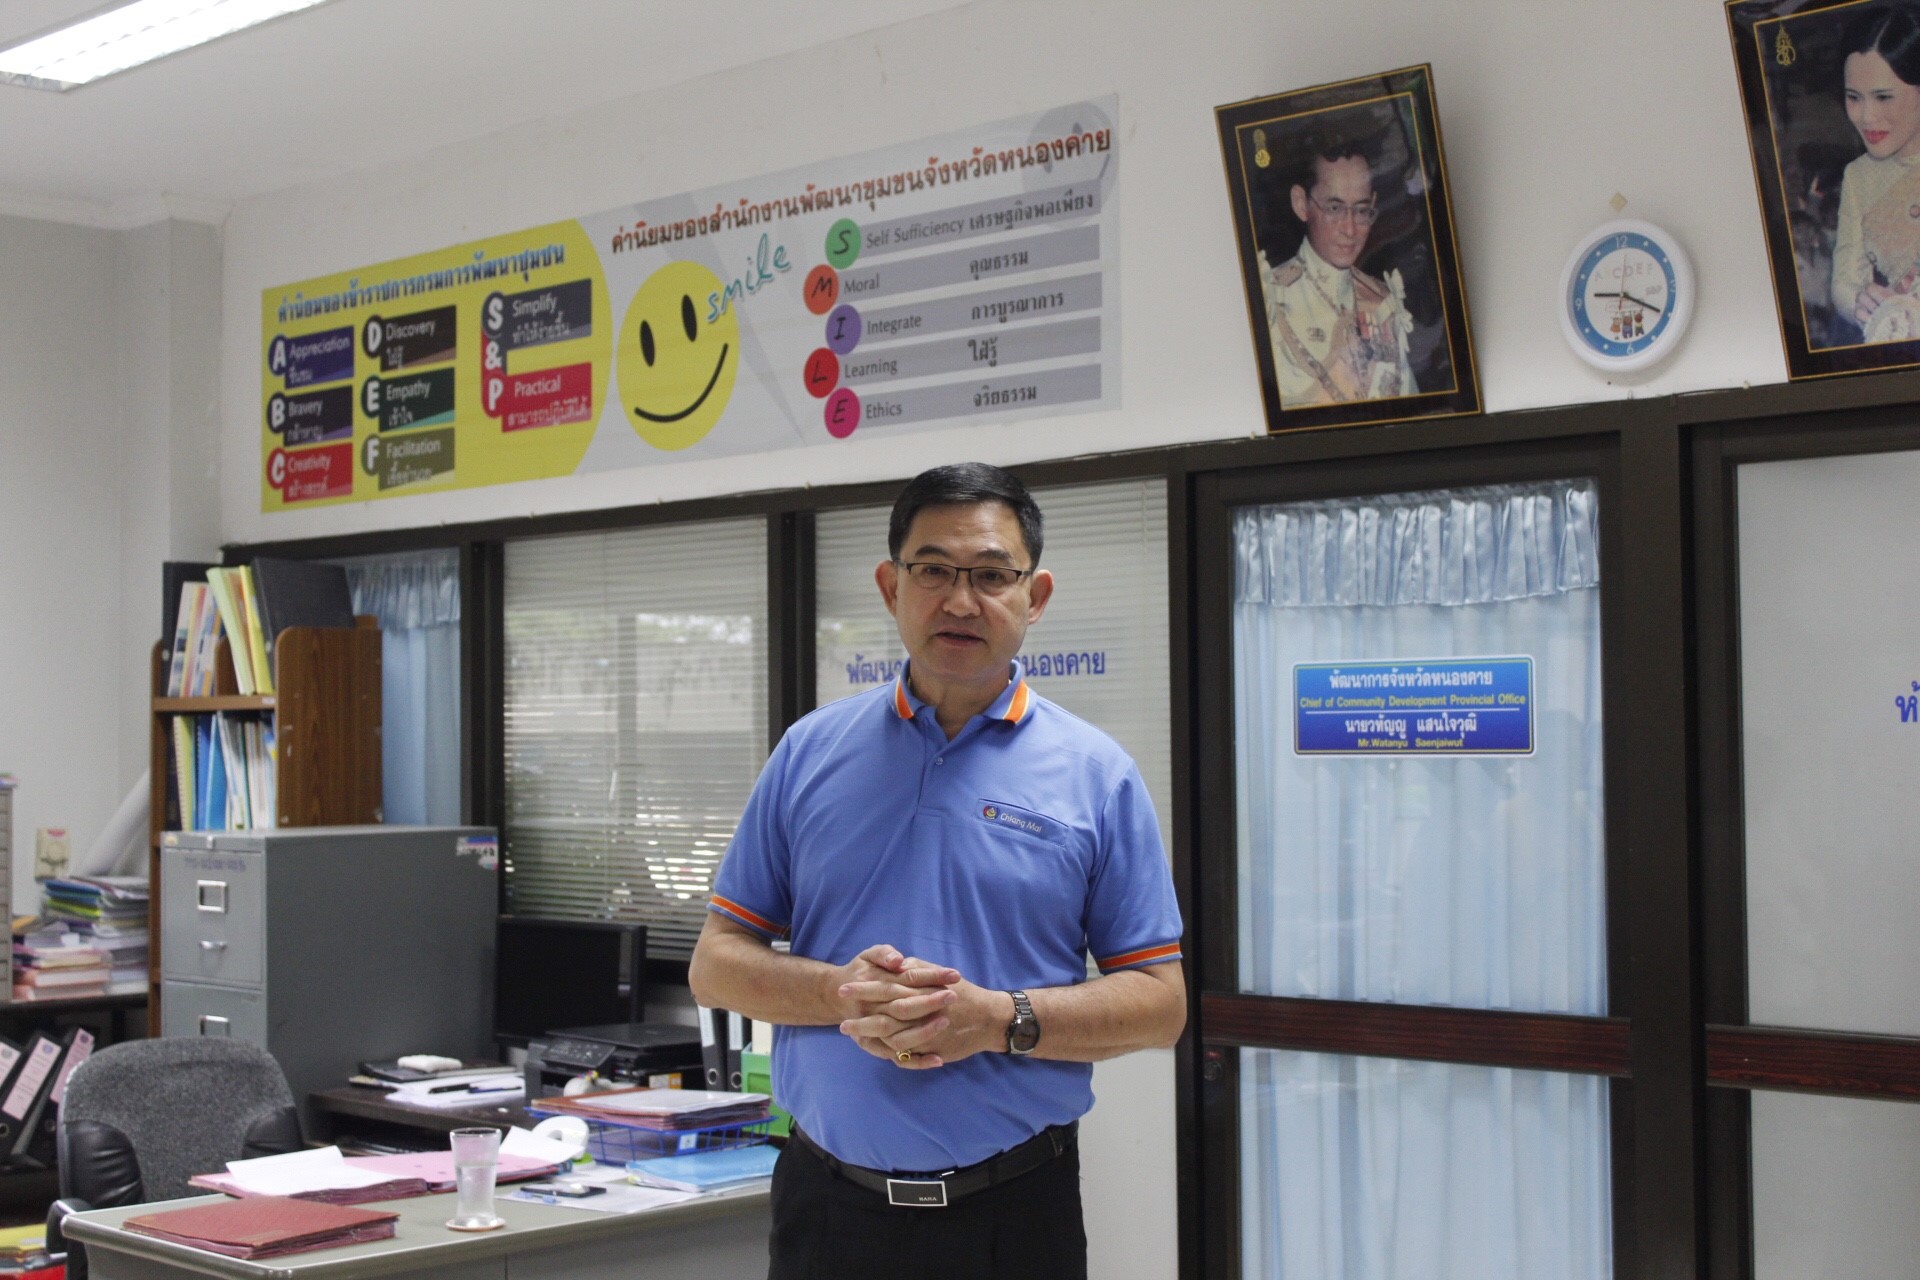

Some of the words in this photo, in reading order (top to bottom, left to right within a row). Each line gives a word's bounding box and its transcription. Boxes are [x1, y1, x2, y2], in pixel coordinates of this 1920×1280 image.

[612, 128, 1111, 254] ค่านิยมของสำนักงานพัฒนาชุมชนจังหวัดหนองคาย
[970, 188, 1094, 231] เศรษฐกิจพอเพียง
[866, 228, 890, 249] Self
[894, 218, 965, 244] Sufficiency
[1615, 235, 1629, 249] 12
[706, 232, 791, 322] smile
[969, 251, 1029, 281] คุณธรรม
[844, 272, 880, 294] Moral
[487, 296, 504, 331] S
[512, 292, 558, 318] Simplify
[972, 292, 1064, 323] การบูรณาการ
[1575, 298, 1583, 311] 9
[367, 321, 383, 353] D
[385, 321, 436, 341] Discovery
[867, 314, 922, 336] Integrate
[272, 339, 287, 372] A
[289, 335, 351, 362] Appreciation
[485, 341, 503, 370] &
[1626, 341, 1635, 355] 6
[845, 358, 898, 379] Learning
[366, 379, 380, 412] E
[385, 379, 431, 402] Empathy
[488, 378, 504, 412] P
[514, 373, 561, 398] Practical
[974, 385, 1037, 408] จริยธรรม
[271, 398, 286, 429] B
[288, 400, 323, 418] Bravery
[866, 401, 903, 420] Ethics
[367, 437, 380, 471] F
[386, 438, 441, 459] Facilitation
[271, 452, 286, 485] C
[287, 454, 332, 473] Creativity
[1329, 666, 1493, 689] พัฒนาการจังหวัดหนองคาย
[1300, 697, 1322, 708] Chief
[1325, 697, 1335, 708] of
[1337, 696, 1386, 709] Community
[1388, 695, 1447, 708] Development
[1450, 694, 1495, 706] Provincial
[1498, 693, 1526, 705] Office
[1416, 711, 1478, 739] แสนใจวุฒิ
[1415, 737, 1464, 748] Saenjaiwut
[1000, 812, 1026, 829] Chiang
[1026, 821, 1043, 833] Mai
